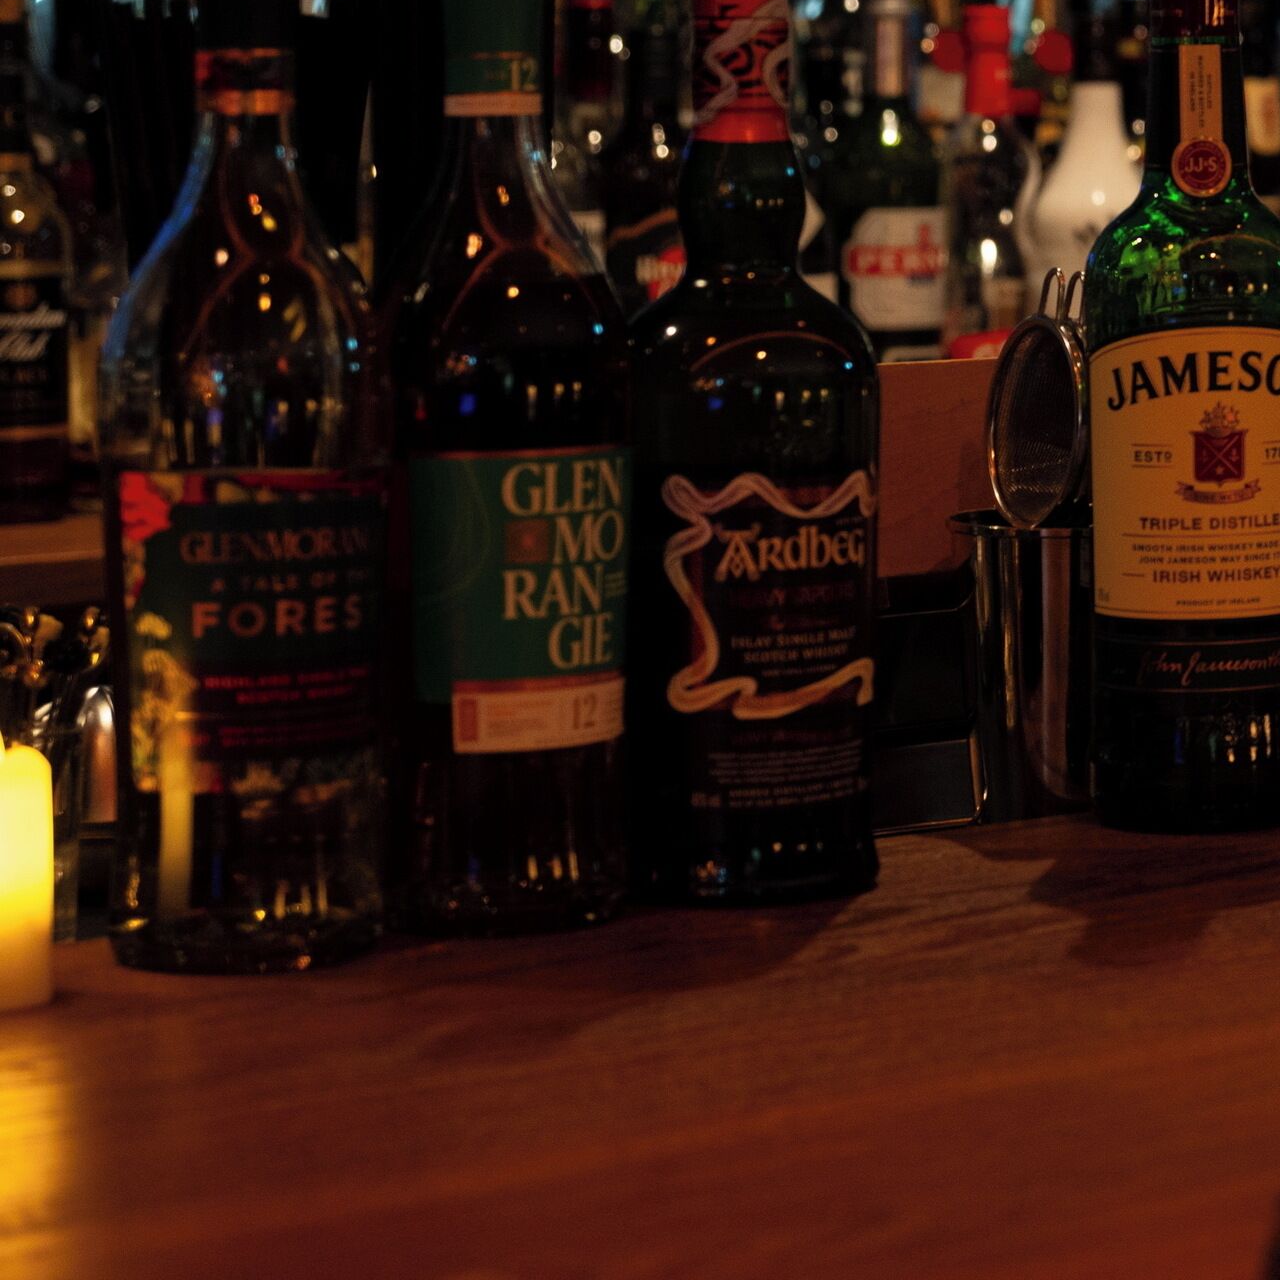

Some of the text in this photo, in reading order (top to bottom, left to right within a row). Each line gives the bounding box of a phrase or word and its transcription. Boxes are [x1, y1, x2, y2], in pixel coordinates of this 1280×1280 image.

[510, 56, 538, 93] 12
[501, 456, 625, 518] GLEN
[553, 509, 625, 565] MO
[1138, 516, 1203, 531] TRIPLE
[1132, 543, 1173, 553] SMOOTH
[1175, 543, 1205, 553] IRISH
[1207, 542, 1253, 552] WHISKEY
[1137, 552, 1271, 565] JOHN JAMESON WAY SINCE
[502, 562, 604, 621] RAN
[1152, 570, 1201, 584] IRISH
[547, 610, 614, 670] GIE
[572, 693, 598, 731] 12
